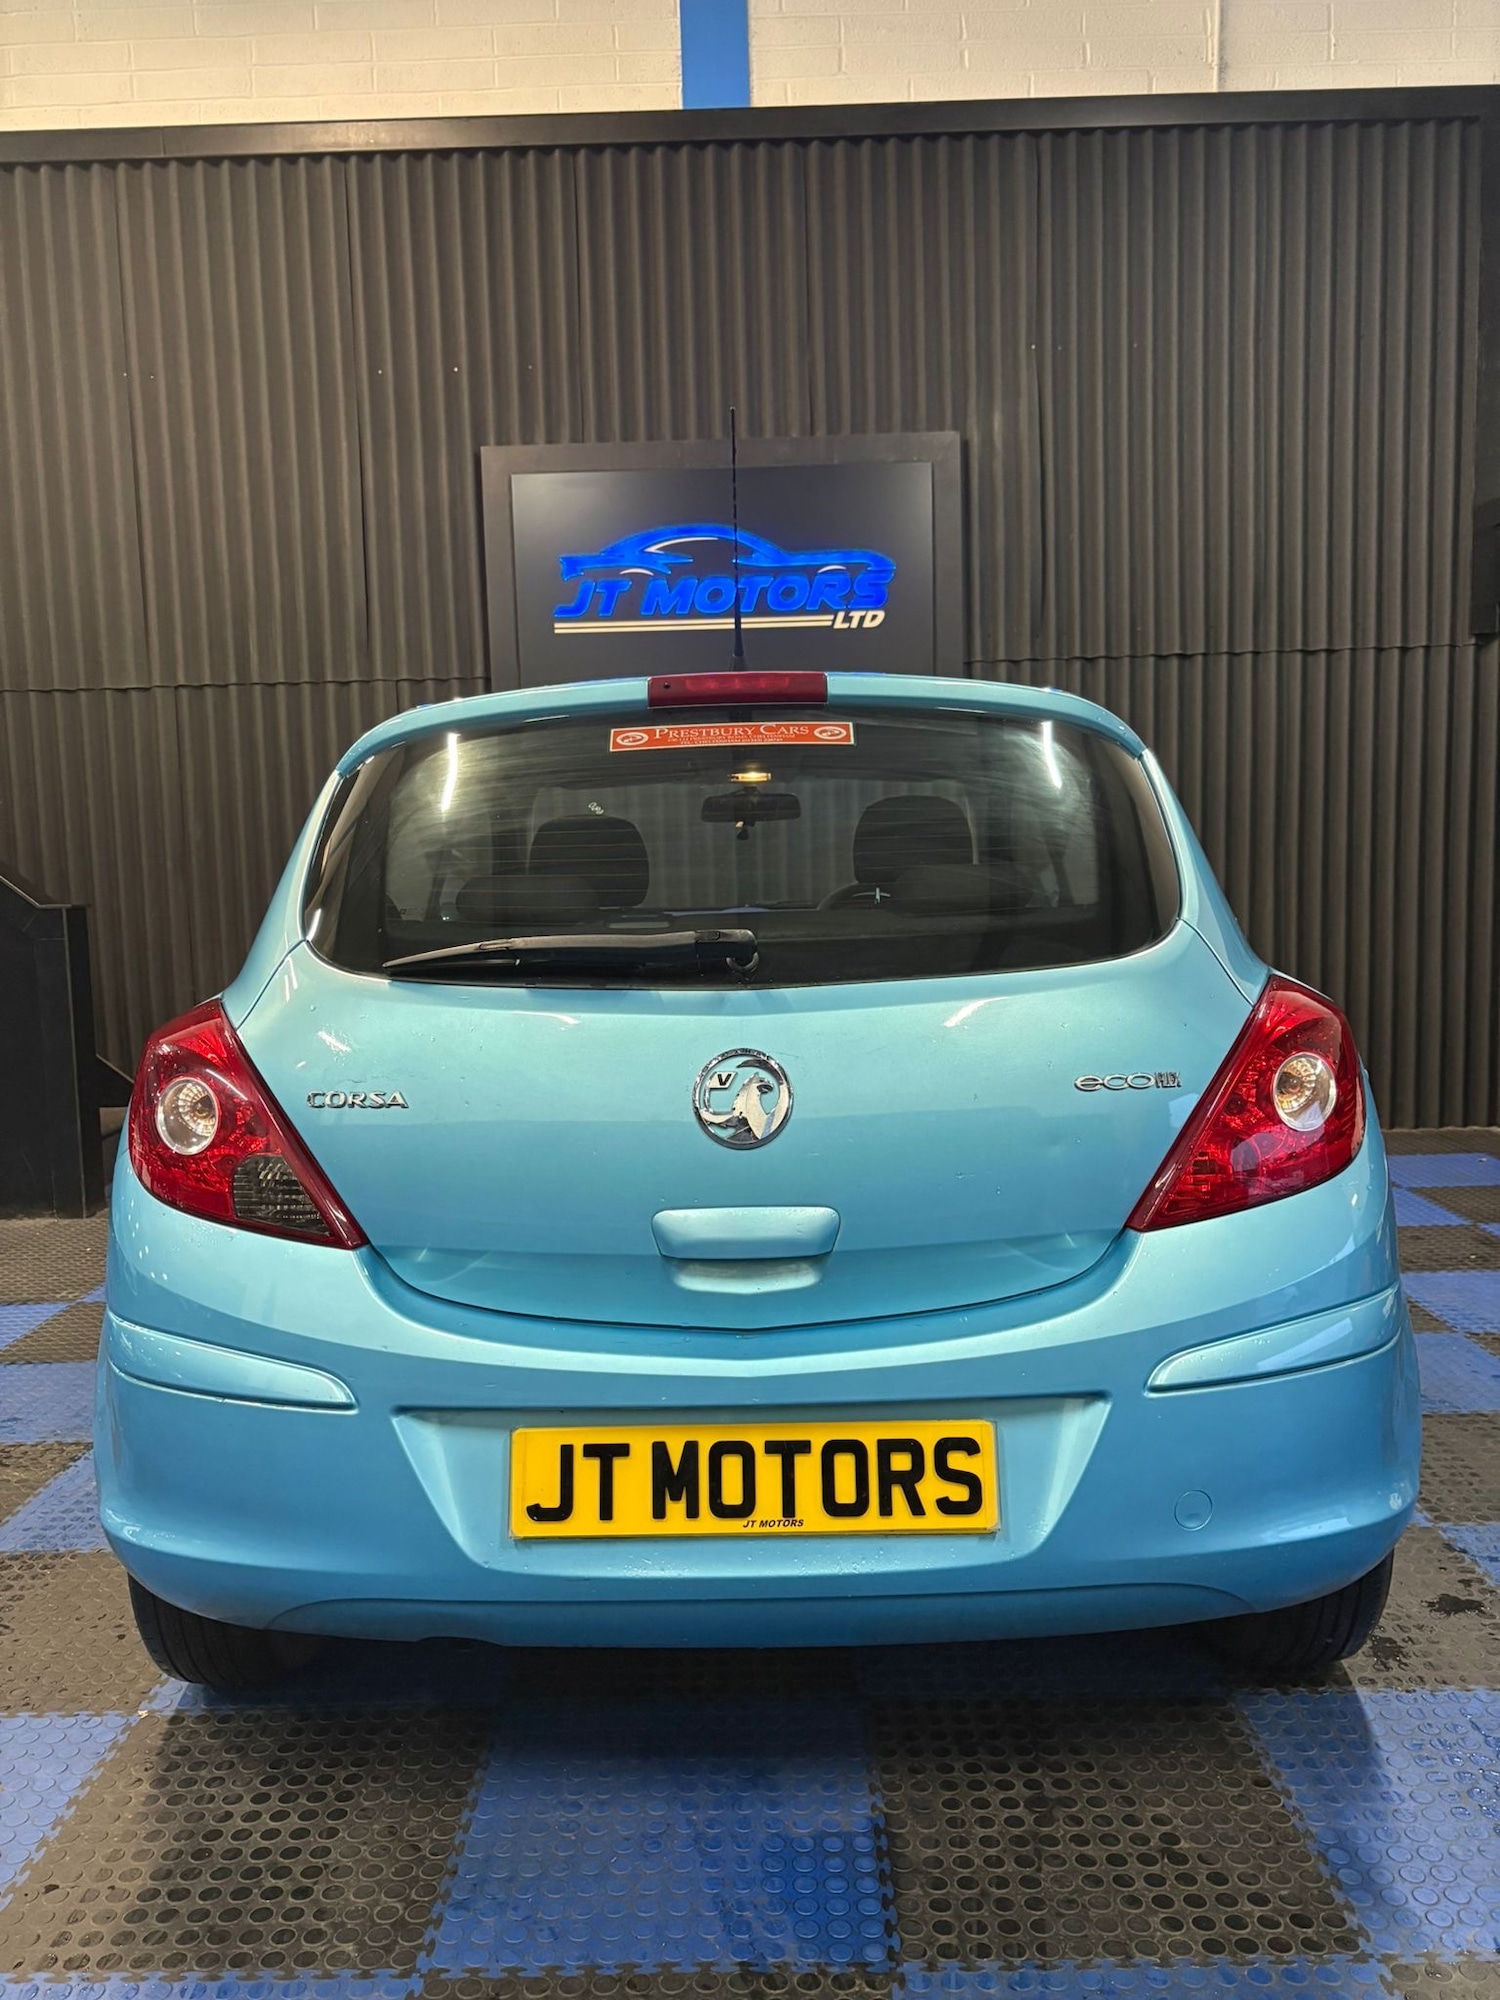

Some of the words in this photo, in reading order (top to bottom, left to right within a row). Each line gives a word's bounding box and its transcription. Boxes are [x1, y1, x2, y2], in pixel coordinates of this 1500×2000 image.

[554, 579, 632, 617] JT
[640, 570, 896, 616] MOTORS
[833, 610, 886, 629] LTD
[654, 727, 756, 740] PRESTBURY
[759, 724, 809, 735] CARS
[307, 1090, 409, 1109] CORSA
[526, 1443, 630, 1521] JT
[651, 1437, 983, 1519] MOTORS
[743, 1520, 757, 1528] JT
[759, 1519, 804, 1528] MOTORS
